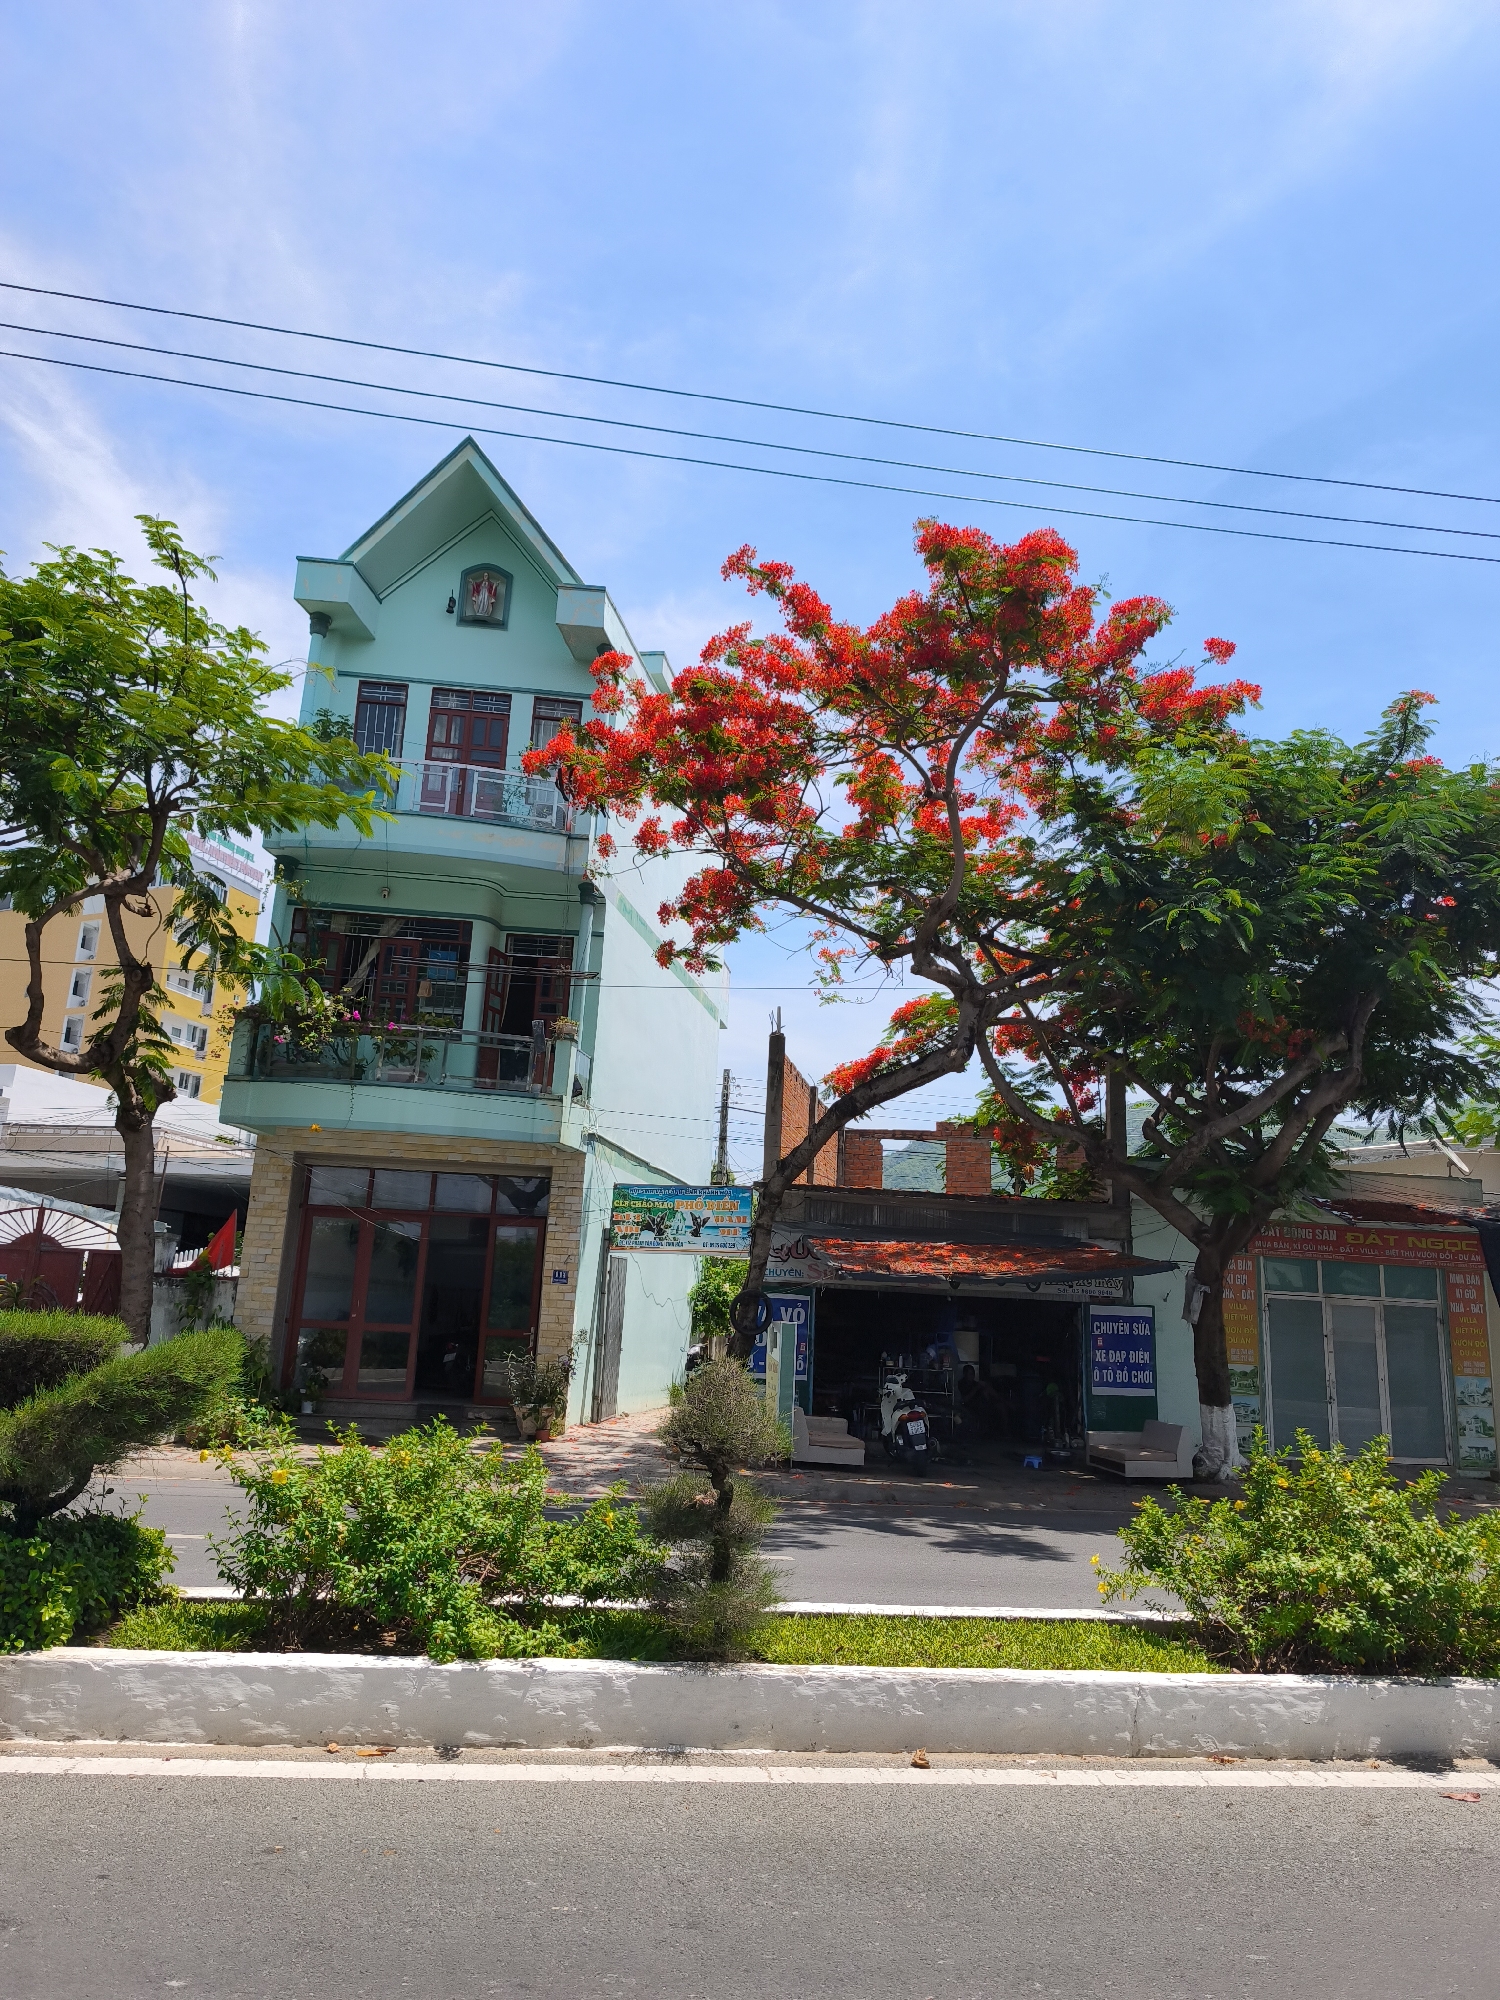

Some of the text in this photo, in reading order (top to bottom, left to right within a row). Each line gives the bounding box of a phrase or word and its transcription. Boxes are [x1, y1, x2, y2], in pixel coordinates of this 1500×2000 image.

[614, 1199, 629, 1207] CLB
[675, 1195, 705, 1210] PHỐ
[1315, 1226, 1337, 1241] SẢN
[1345, 1229, 1478, 1252] ĐẤT NGỌC
[1255, 1240, 1272, 1248] MUA
[1318, 1243, 1334, 1251] NHÀ
[1340, 1244, 1354, 1253] ĐẤT
[1385, 1249, 1399, 1257] BIỆT
[1471, 1252, 1481, 1261] ÁN
[1449, 1272, 1480, 1286] MUA BÁN
[780, 1302, 806, 1324] VỎ
[1450, 1300, 1464, 1313] NHÀ
[1470, 1300, 1484, 1314] ĐẤT
[1094, 1319, 1151, 1336] CHUYÊN SỬA
[1455, 1325, 1484, 1337] BIỆT THỰ
[1095, 1348, 1150, 1366] XE ĐẠP ĐIỆN
[1094, 1365, 1153, 1383] Ô TÔ ĐỒ CHƠI
